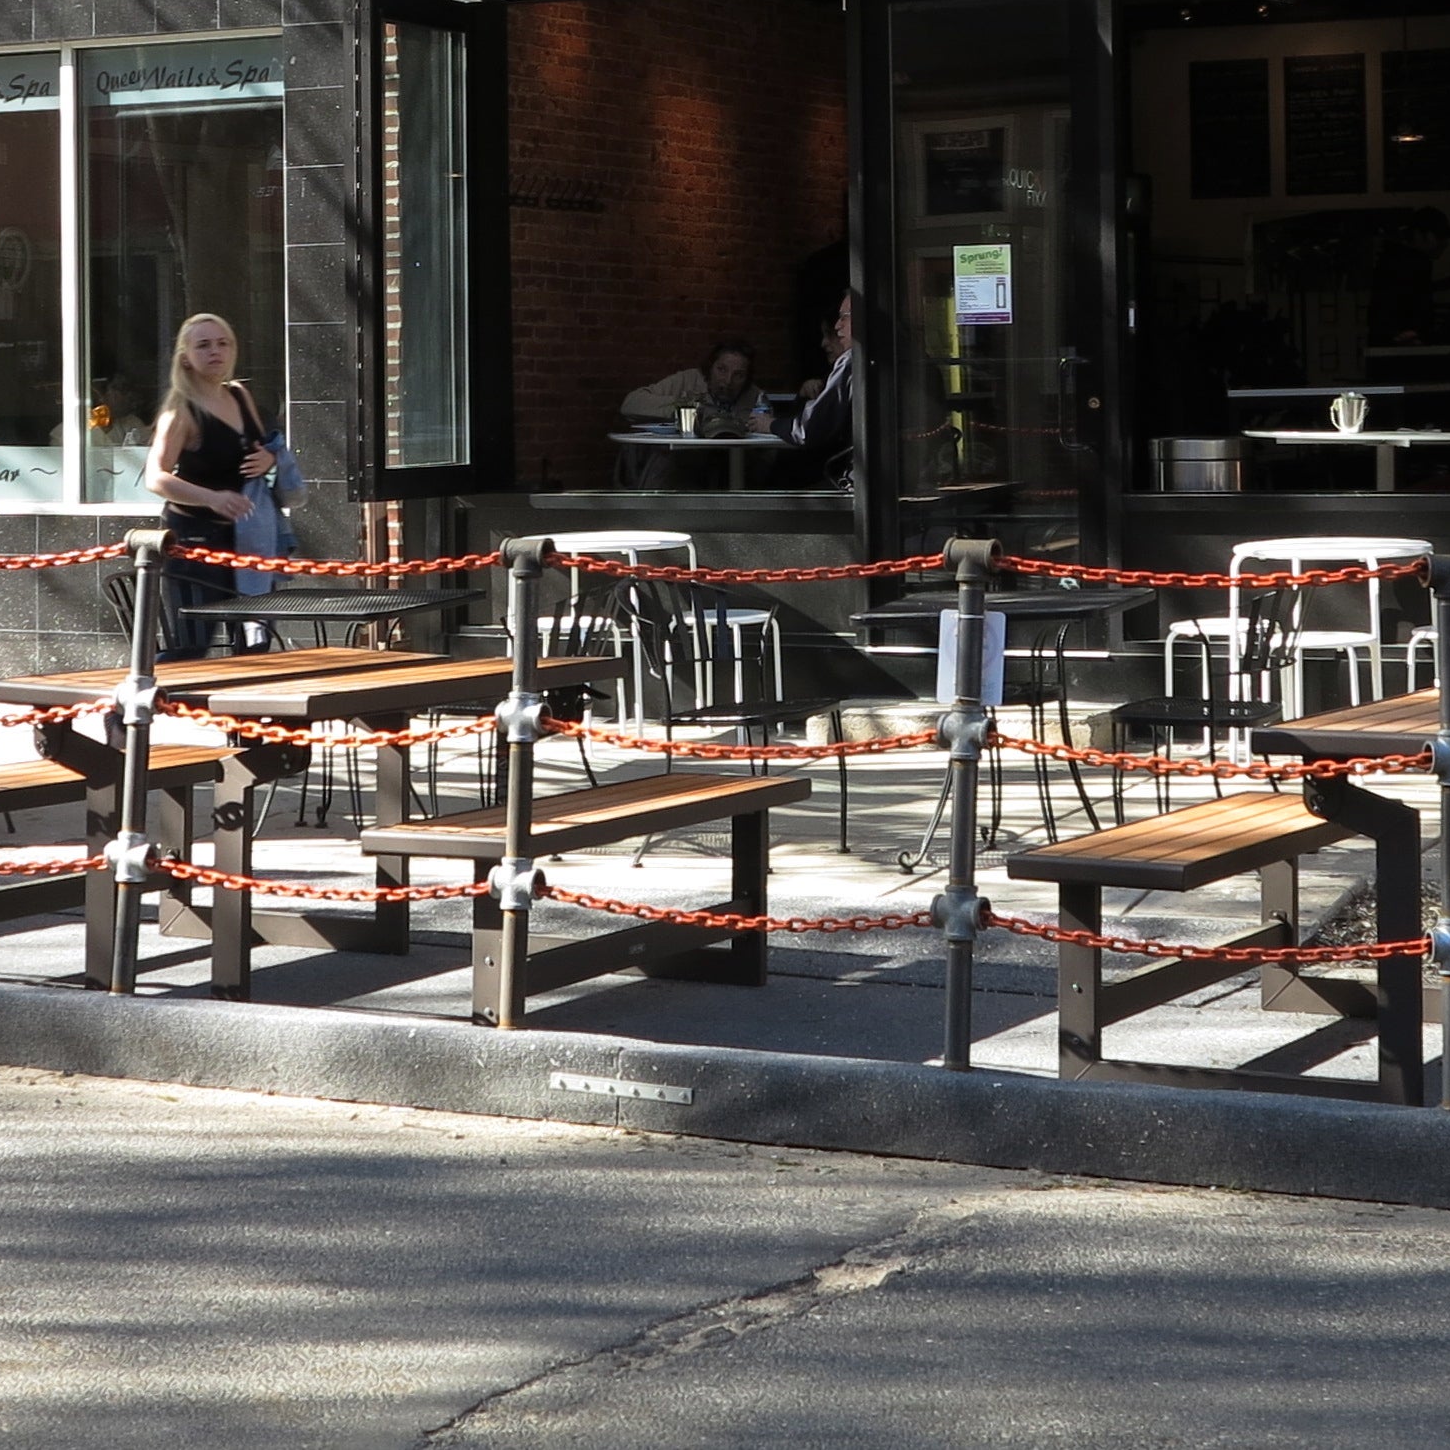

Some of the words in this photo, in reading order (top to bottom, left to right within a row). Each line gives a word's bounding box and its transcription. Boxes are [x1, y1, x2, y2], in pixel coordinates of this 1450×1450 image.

[4, 73, 51, 103] Spa
[96, 66, 149, 95] Queen
[219, 59, 271, 92] Spa
